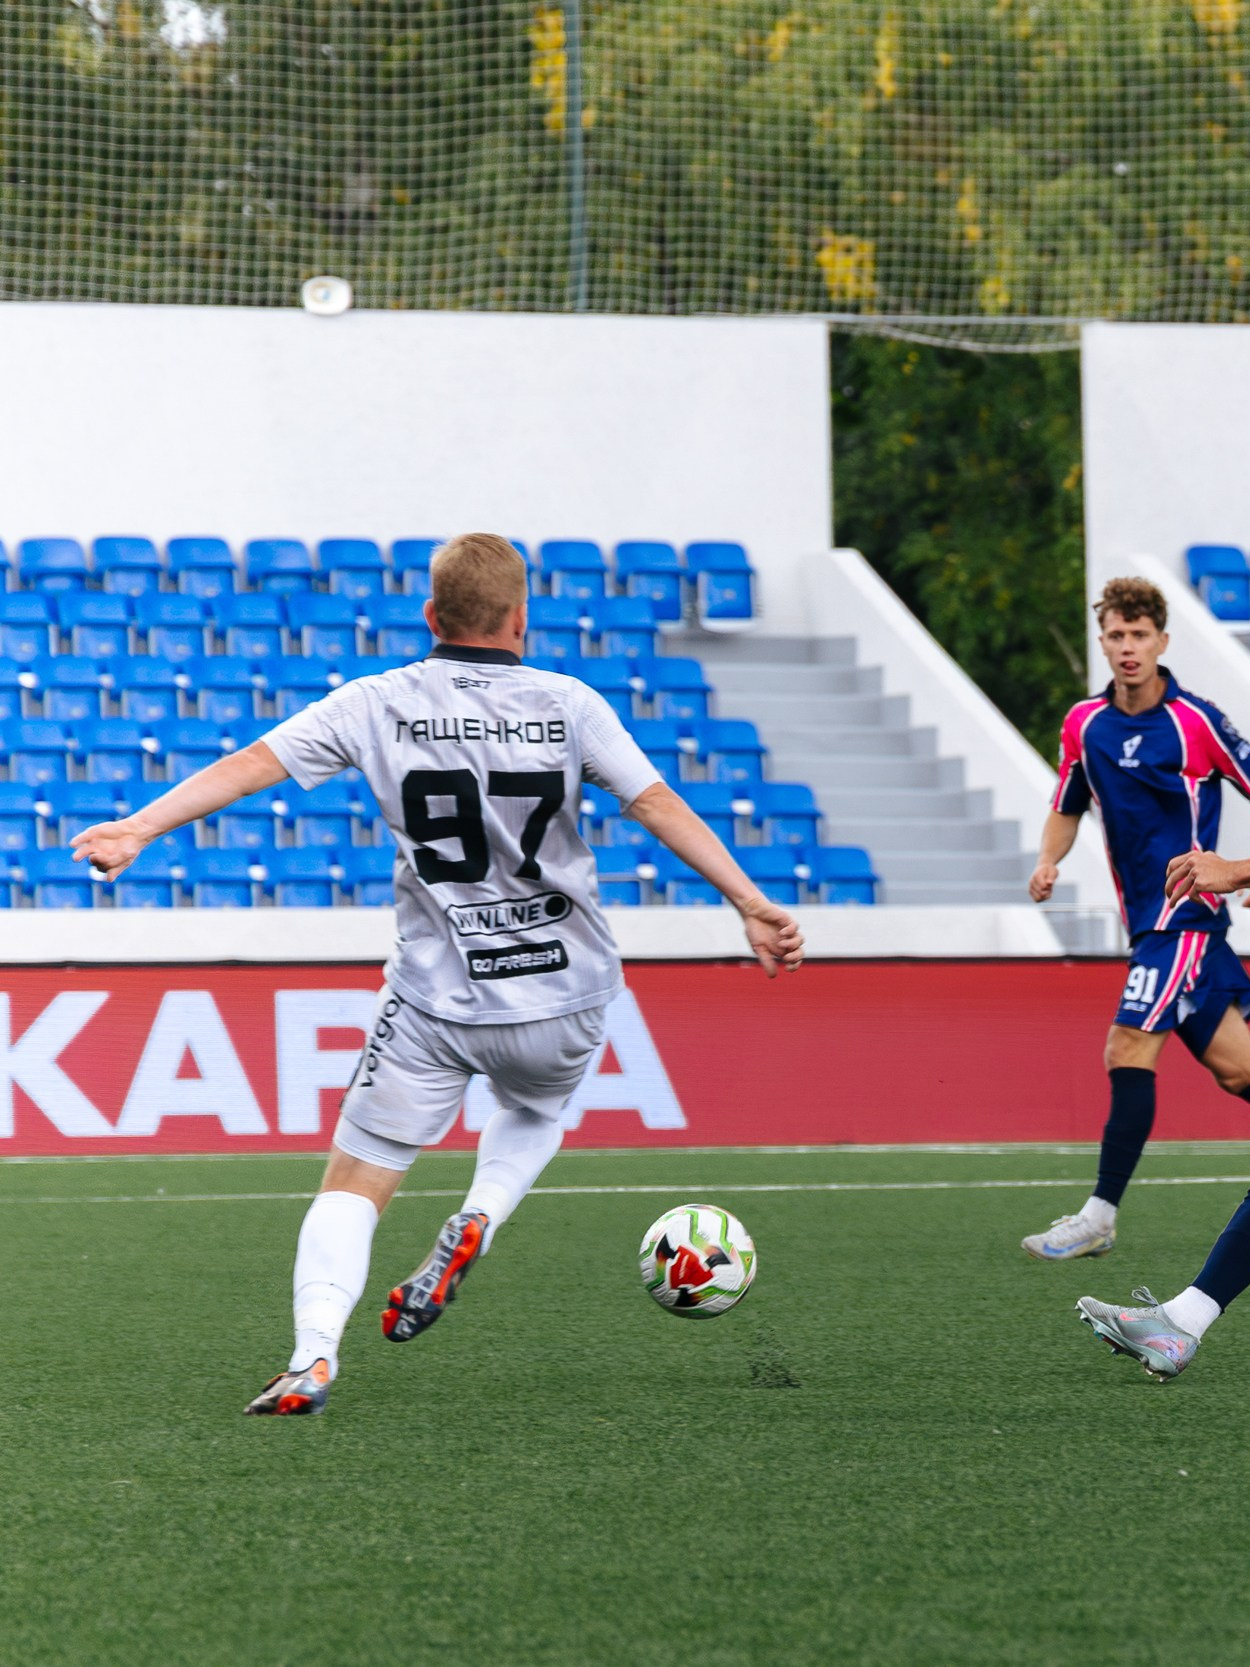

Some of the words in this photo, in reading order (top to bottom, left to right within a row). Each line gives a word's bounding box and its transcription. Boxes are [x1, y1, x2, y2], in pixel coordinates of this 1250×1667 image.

[396, 717, 566, 745] ГАЩЕНКОВ
[401, 768, 566, 885] 97
[1123, 965, 1159, 1004] 91
[0, 990, 688, 1137] КАРА
